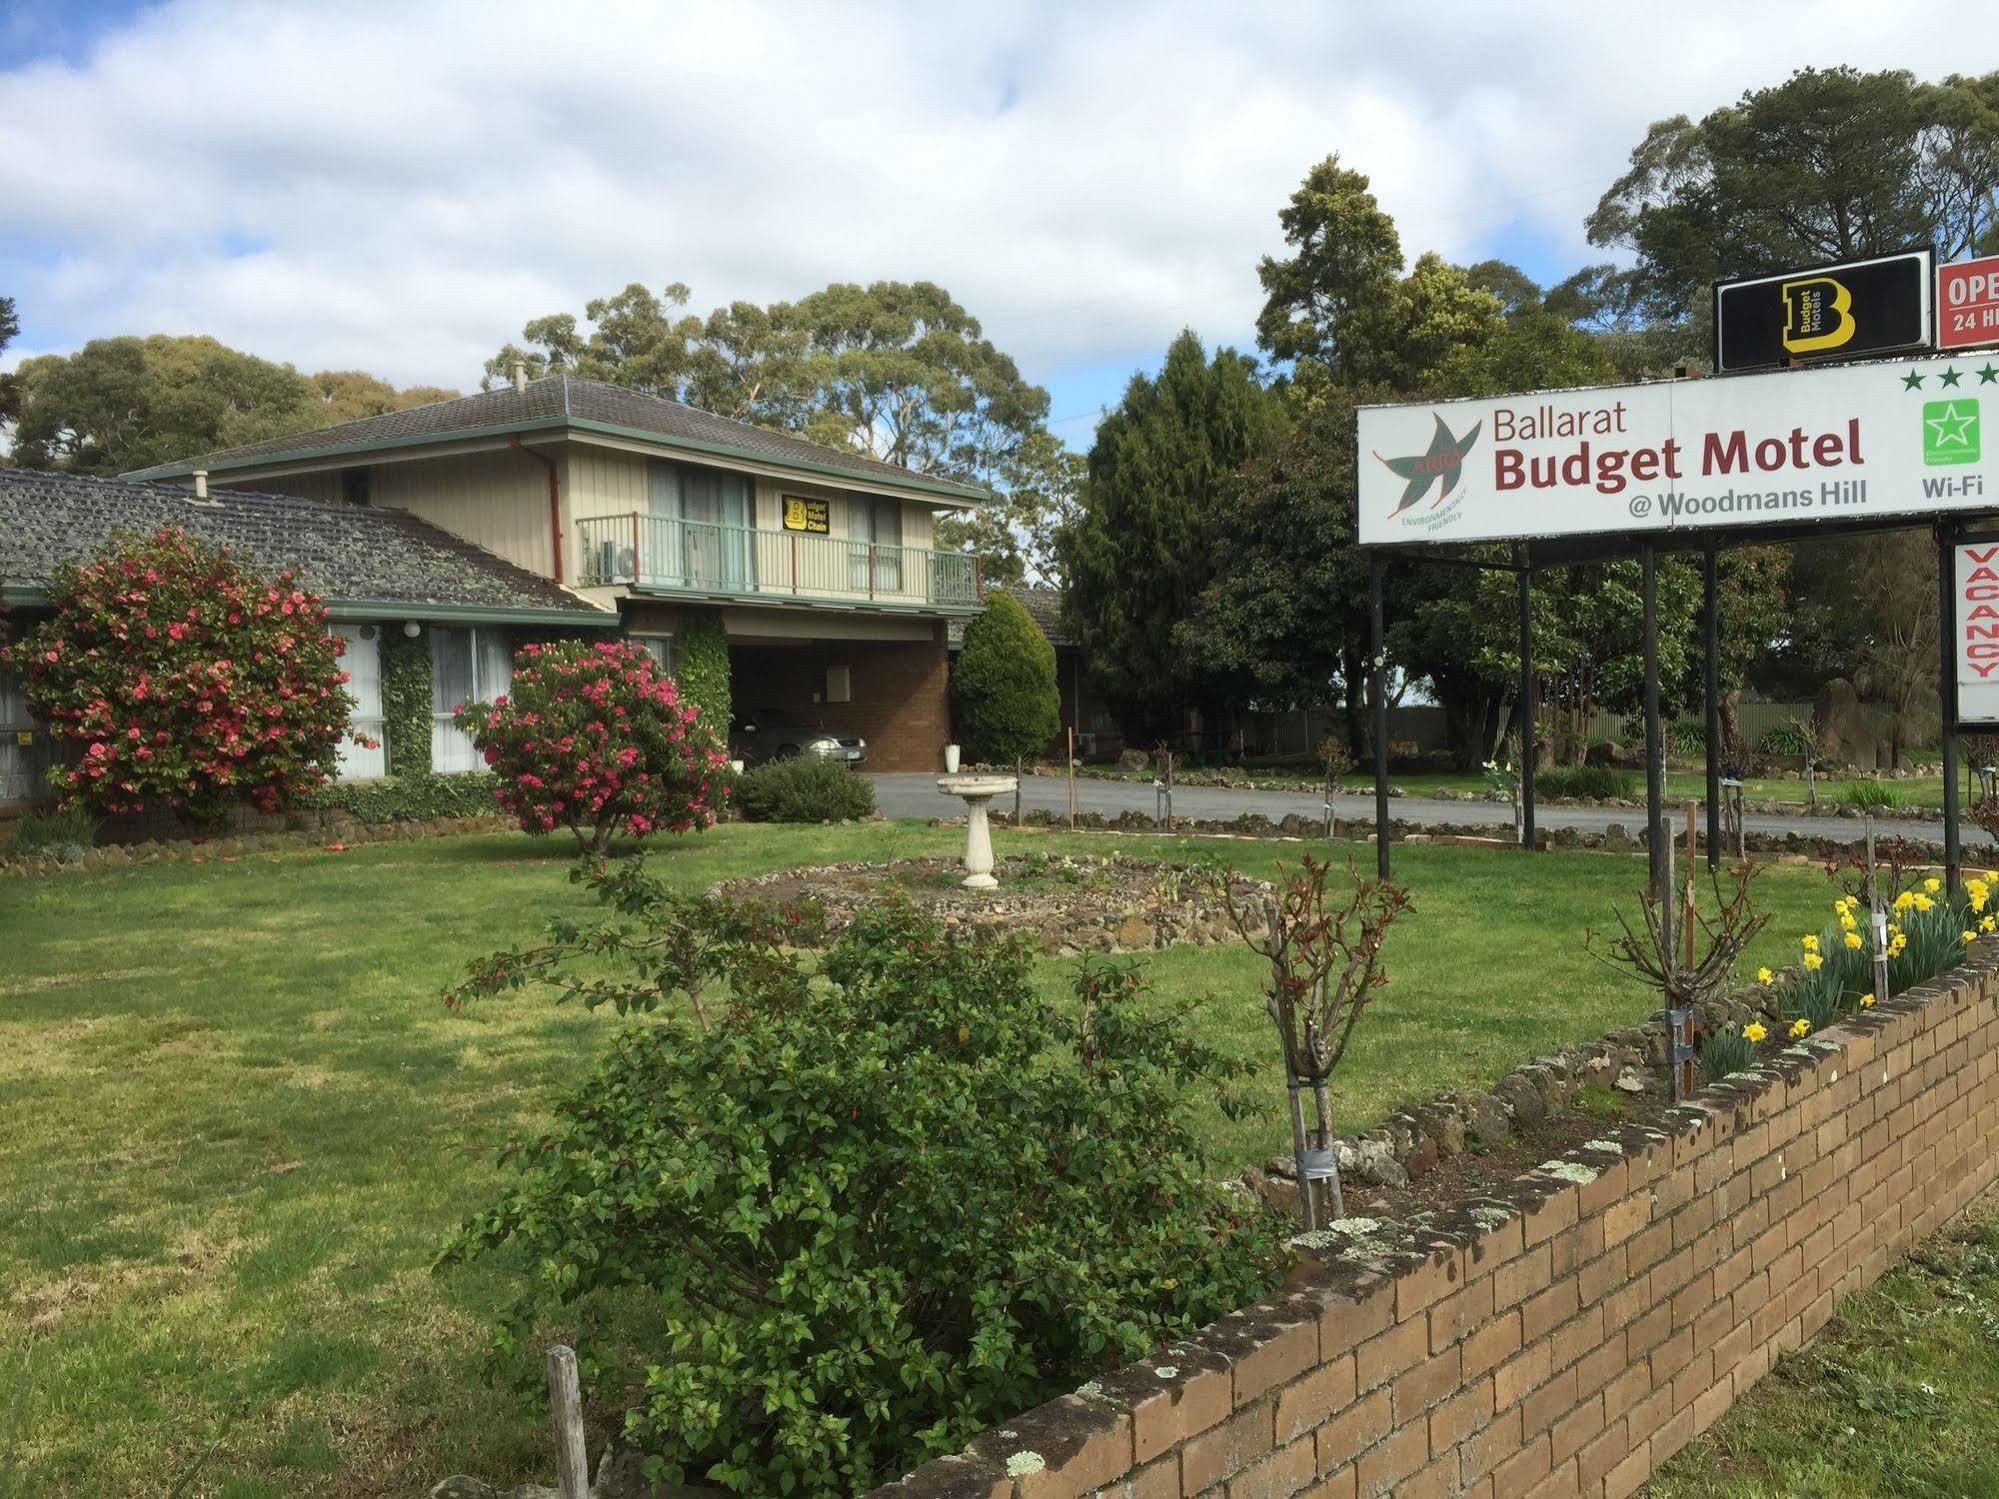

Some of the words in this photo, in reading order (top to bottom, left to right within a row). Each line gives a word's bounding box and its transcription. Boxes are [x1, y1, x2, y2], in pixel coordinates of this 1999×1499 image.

[1800, 289, 1812, 333] Budget
[1811, 291, 1822, 331] Motels
[1953, 312, 1977, 332] 24
[1494, 401, 1627, 442] Ballarat
[1494, 438, 1683, 494] Budget
[1702, 417, 1865, 476] Motel
[1628, 494, 1652, 519] @
[1657, 488, 1814, 517] Woodmans
[1820, 479, 1867, 506] Hill
[1922, 474, 1983, 499] Wi-Fi
[1427, 511, 1463, 533] FRIENDLY
[1964, 547, 1999, 678] VACANCY
